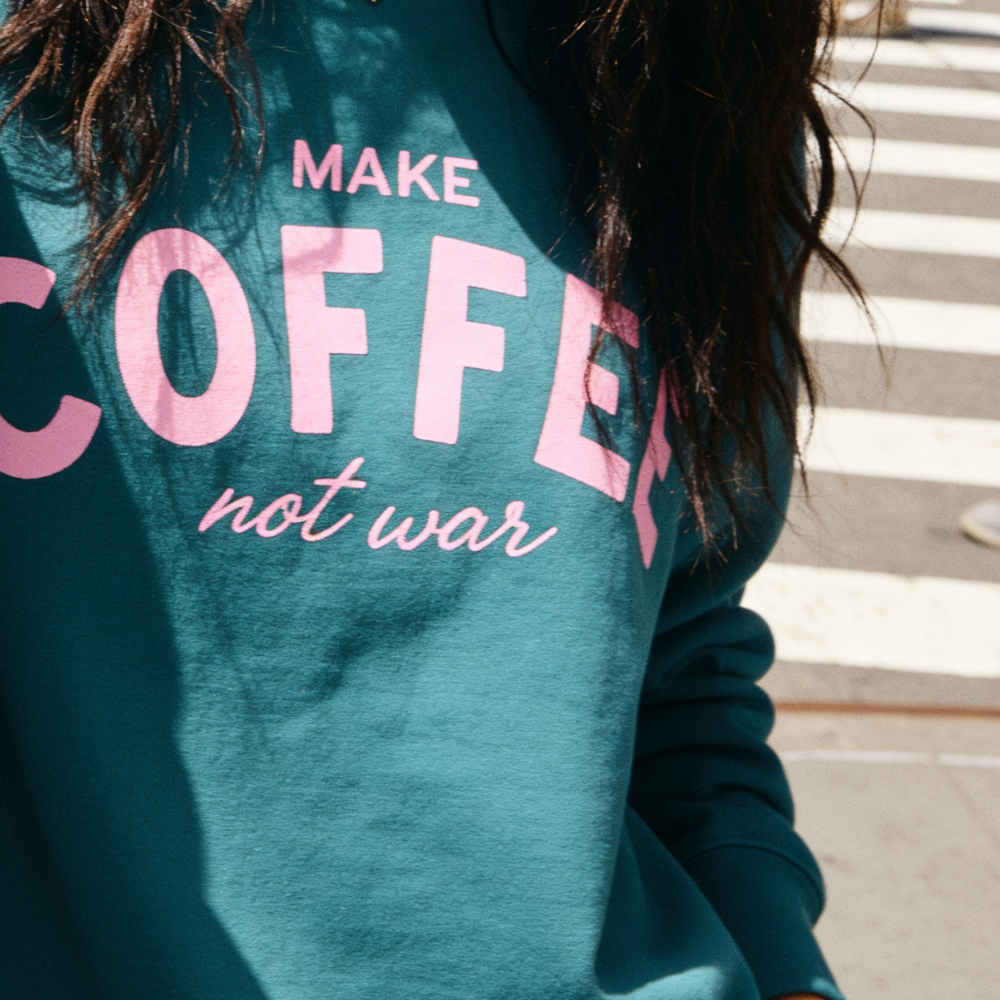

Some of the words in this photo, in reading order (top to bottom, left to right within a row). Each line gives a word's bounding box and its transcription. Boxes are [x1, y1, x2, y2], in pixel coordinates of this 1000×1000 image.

[292, 139, 480, 207] MAKE
[198, 456, 367, 541] not
[367, 500, 558, 557] war
